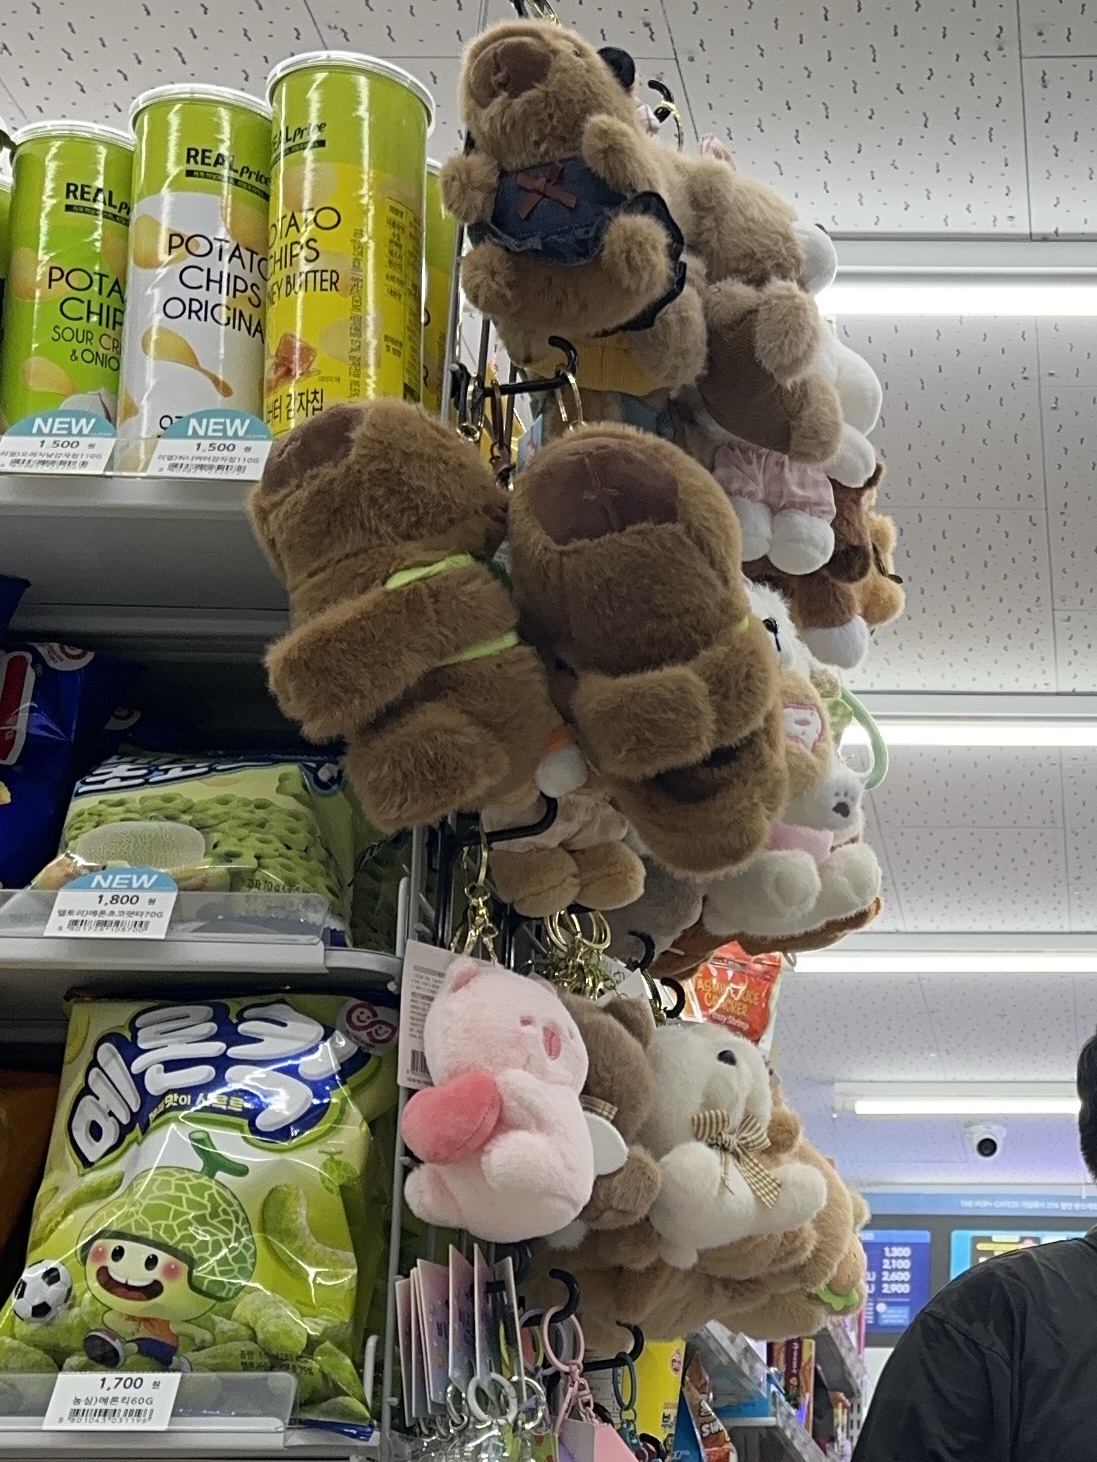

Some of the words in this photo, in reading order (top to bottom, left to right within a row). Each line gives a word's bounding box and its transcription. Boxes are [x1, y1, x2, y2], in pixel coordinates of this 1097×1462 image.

[269, 206, 341, 243] OTATO
[179, 265, 262, 309] CHIPS
[285, 269, 340, 296] BUTTER
[52, 325, 93, 346] SOUR
[32, 418, 96, 435] NEW
[187, 418, 250, 437] NEW
[90, 875, 158, 889] NEW
[97, 894, 139, 907] 1,800
[100, 1377, 143, 1391] 1,700
